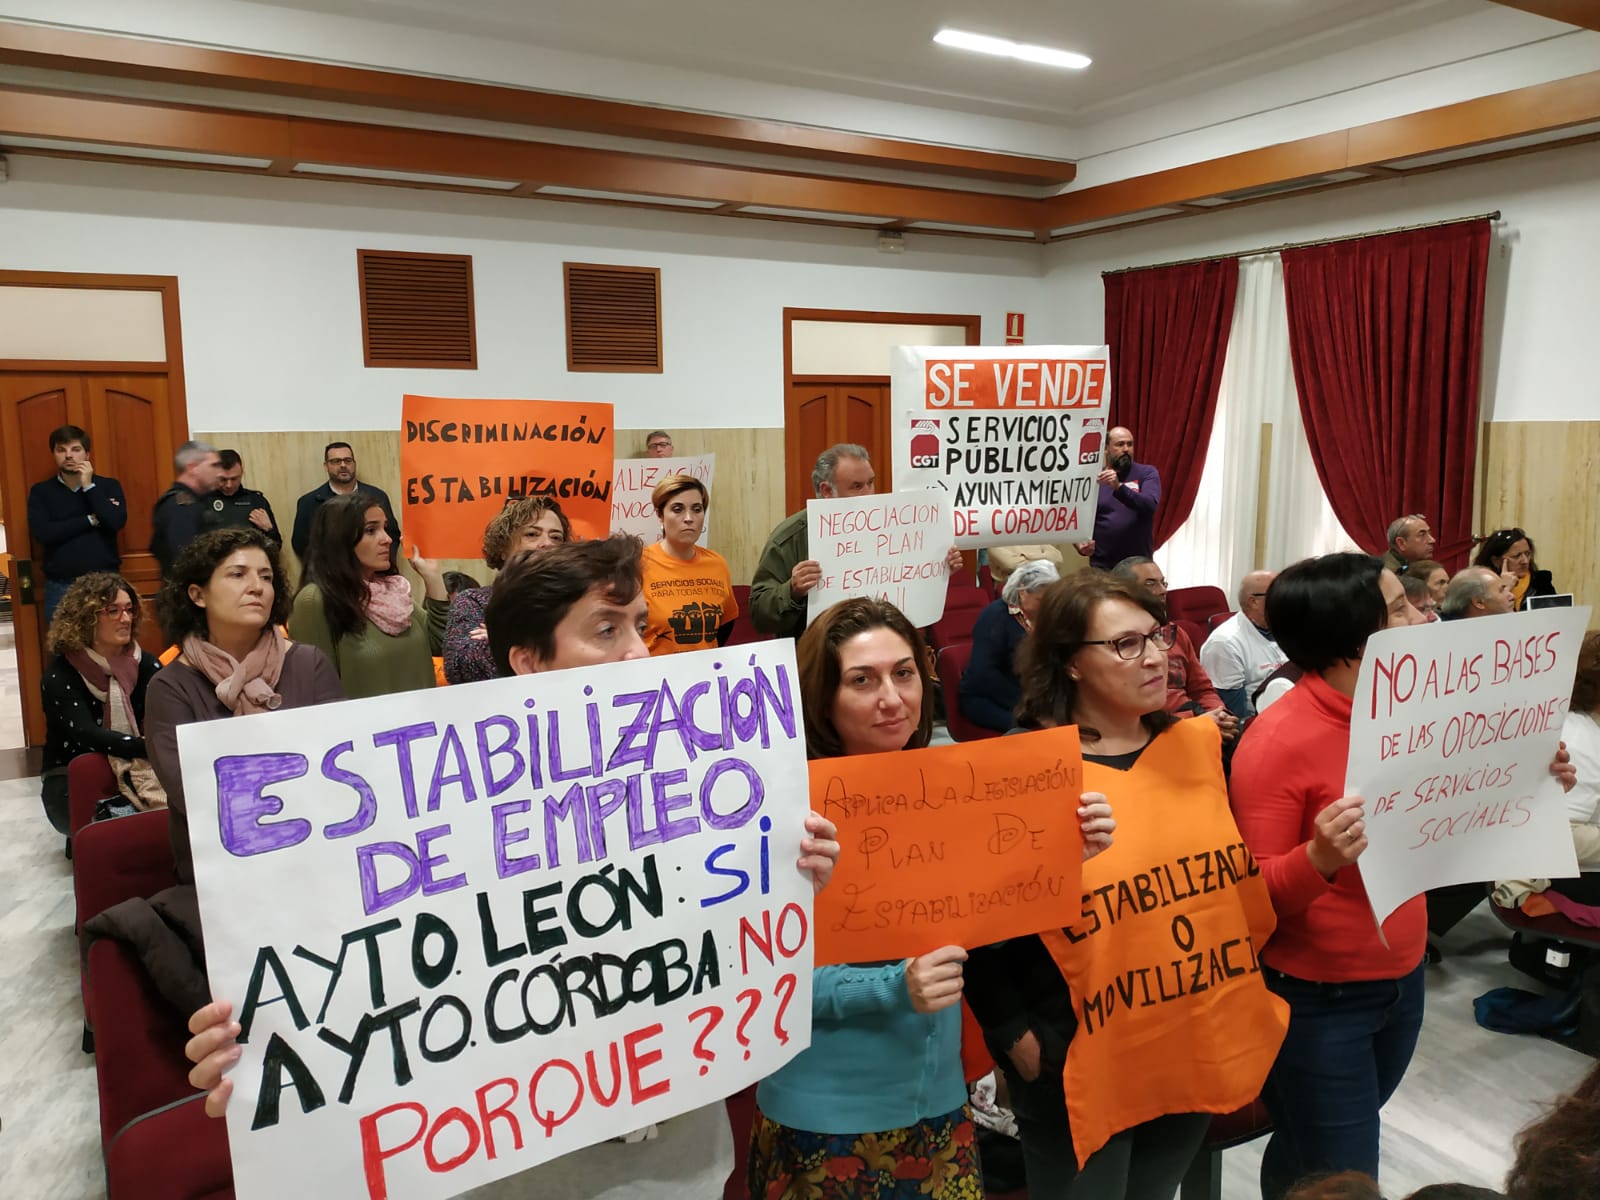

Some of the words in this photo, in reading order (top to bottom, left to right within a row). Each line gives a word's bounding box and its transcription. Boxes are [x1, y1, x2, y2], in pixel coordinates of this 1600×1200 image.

[929, 362, 975, 407] SE
[993, 362, 1104, 407] VENDE
[406, 415, 606, 445] DISCRIMINACIÓN
[946, 414, 1071, 444] SERVICIOS
[912, 454, 939, 468] CGT
[946, 443, 1070, 475] PÚBLICOS
[1080, 450, 1099, 464] CGT
[406, 469, 612, 505] ESTABILIZACIÓN
[954, 475, 1092, 507] AYUNTAMIENTO
[819, 503, 940, 539] NEGOCIACION
[954, 509, 980, 537] DE
[991, 506, 1079, 536] CÓRDOBA
[836, 540, 862, 557] DEL
[876, 530, 924, 557] PLAN
[650, 579, 694, 590] SERVICIOS
[650, 589, 674, 598] PARA
[677, 587, 703, 596] TODAS
[815, 576, 835, 592] DE
[1371, 651, 1417, 720] NO
[1421, 659, 1438, 704] A
[1444, 651, 1483, 696] LAS
[1491, 632, 1561, 685] BASES
[1381, 732, 1402, 761] DE
[1408, 721, 1437, 754] LAS
[1442, 697, 1569, 758] OPOSICIONES
[213, 653, 797, 857] ESTABILIZACIÓN
[914, 768, 957, 810] LA
[1374, 791, 1402, 817] DE
[1405, 763, 1518, 813] SERVICIOS
[356, 823, 468, 916] DE
[491, 757, 767, 879] EMPLEO
[858, 826, 945, 871] PLAN
[987, 812, 1045, 855] DE
[1408, 796, 1535, 850] SOCIALES
[739, 902, 809, 976] NO
[1171, 914, 1195, 952] O
[1083, 936, 1261, 1036] MOVILIZACI
[360, 1022, 671, 1200] PORQUE
